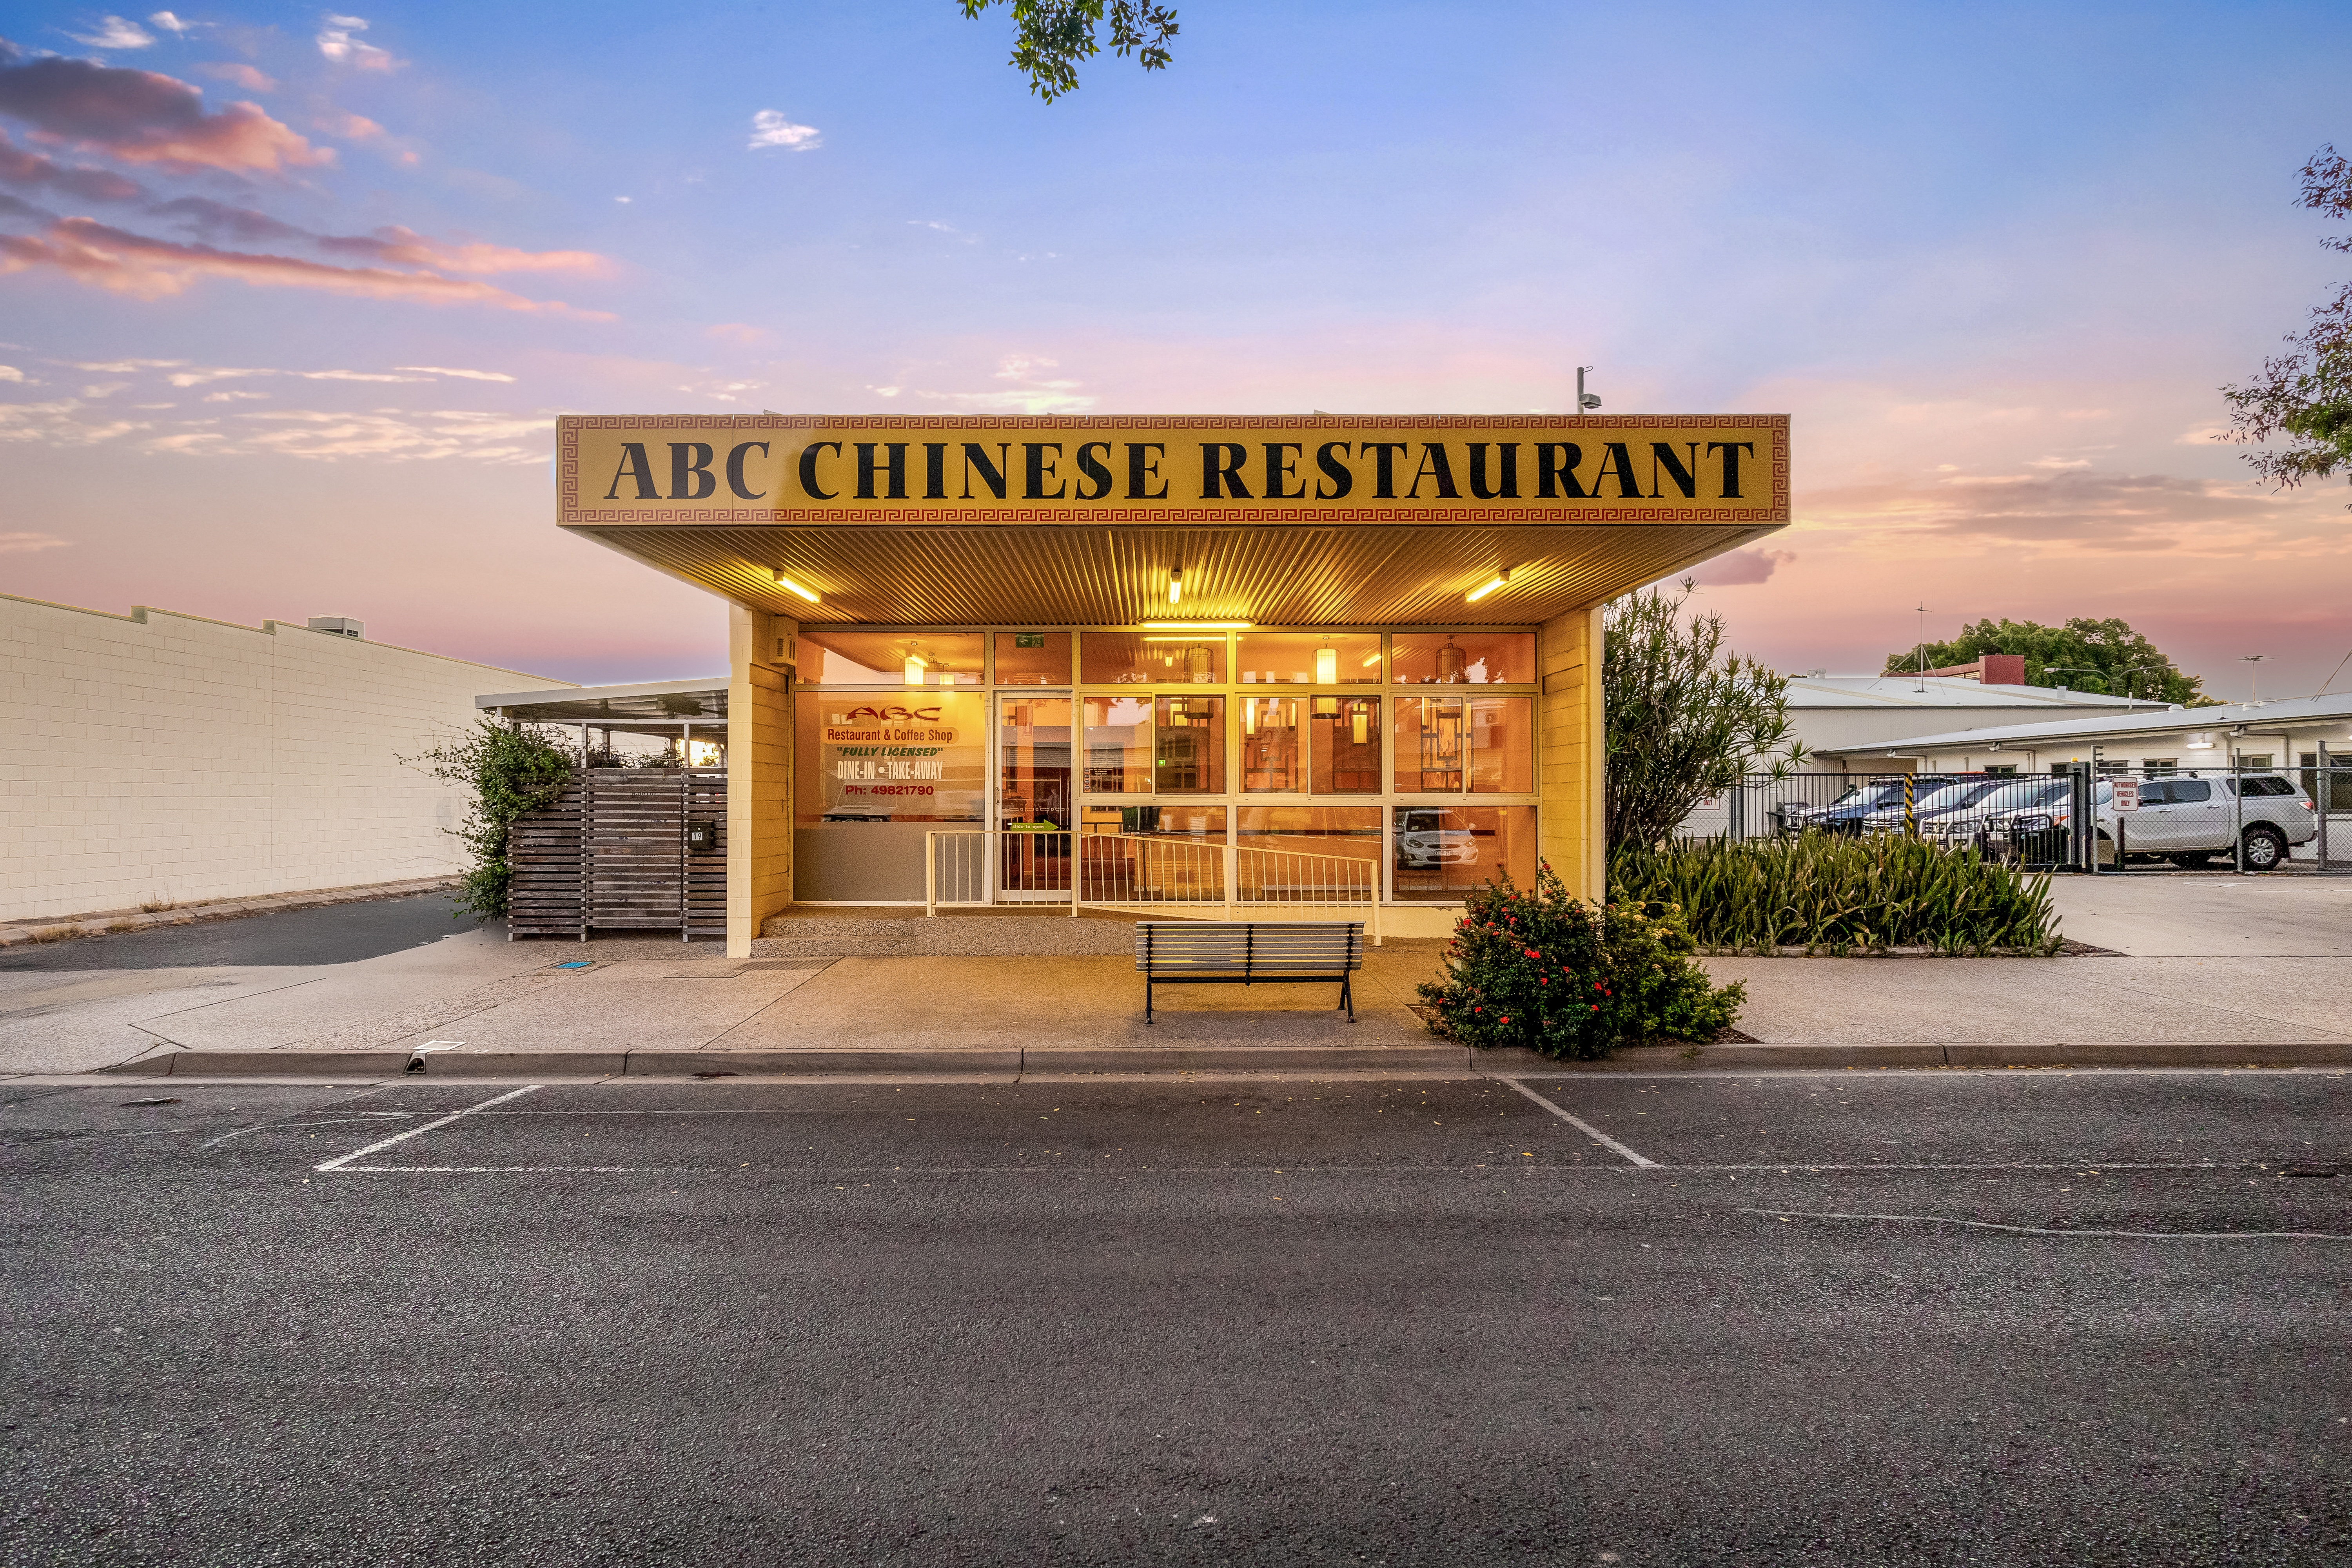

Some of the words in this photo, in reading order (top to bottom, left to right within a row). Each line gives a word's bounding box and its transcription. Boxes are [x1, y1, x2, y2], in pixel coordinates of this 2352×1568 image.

[604, 441, 769, 500] ABC
[799, 441, 1169, 501] CHINESE
[1198, 441, 1754, 500] RESTAURANT
[846, 706, 942, 721] ABC
[828, 729, 880, 740] Restaurant
[884, 729, 890, 740] &
[894, 729, 924, 740] Coffee
[928, 730, 952, 743] Shop
[837, 747, 878, 756] "FULLY
[881, 747, 943, 757] LICENSED"
[837, 761, 875, 779] DINE-IN
[887, 761, 943, 780] TAKE-AWAY
[846, 785, 866, 795] Ph:
[871, 786, 934, 795] 49821790
